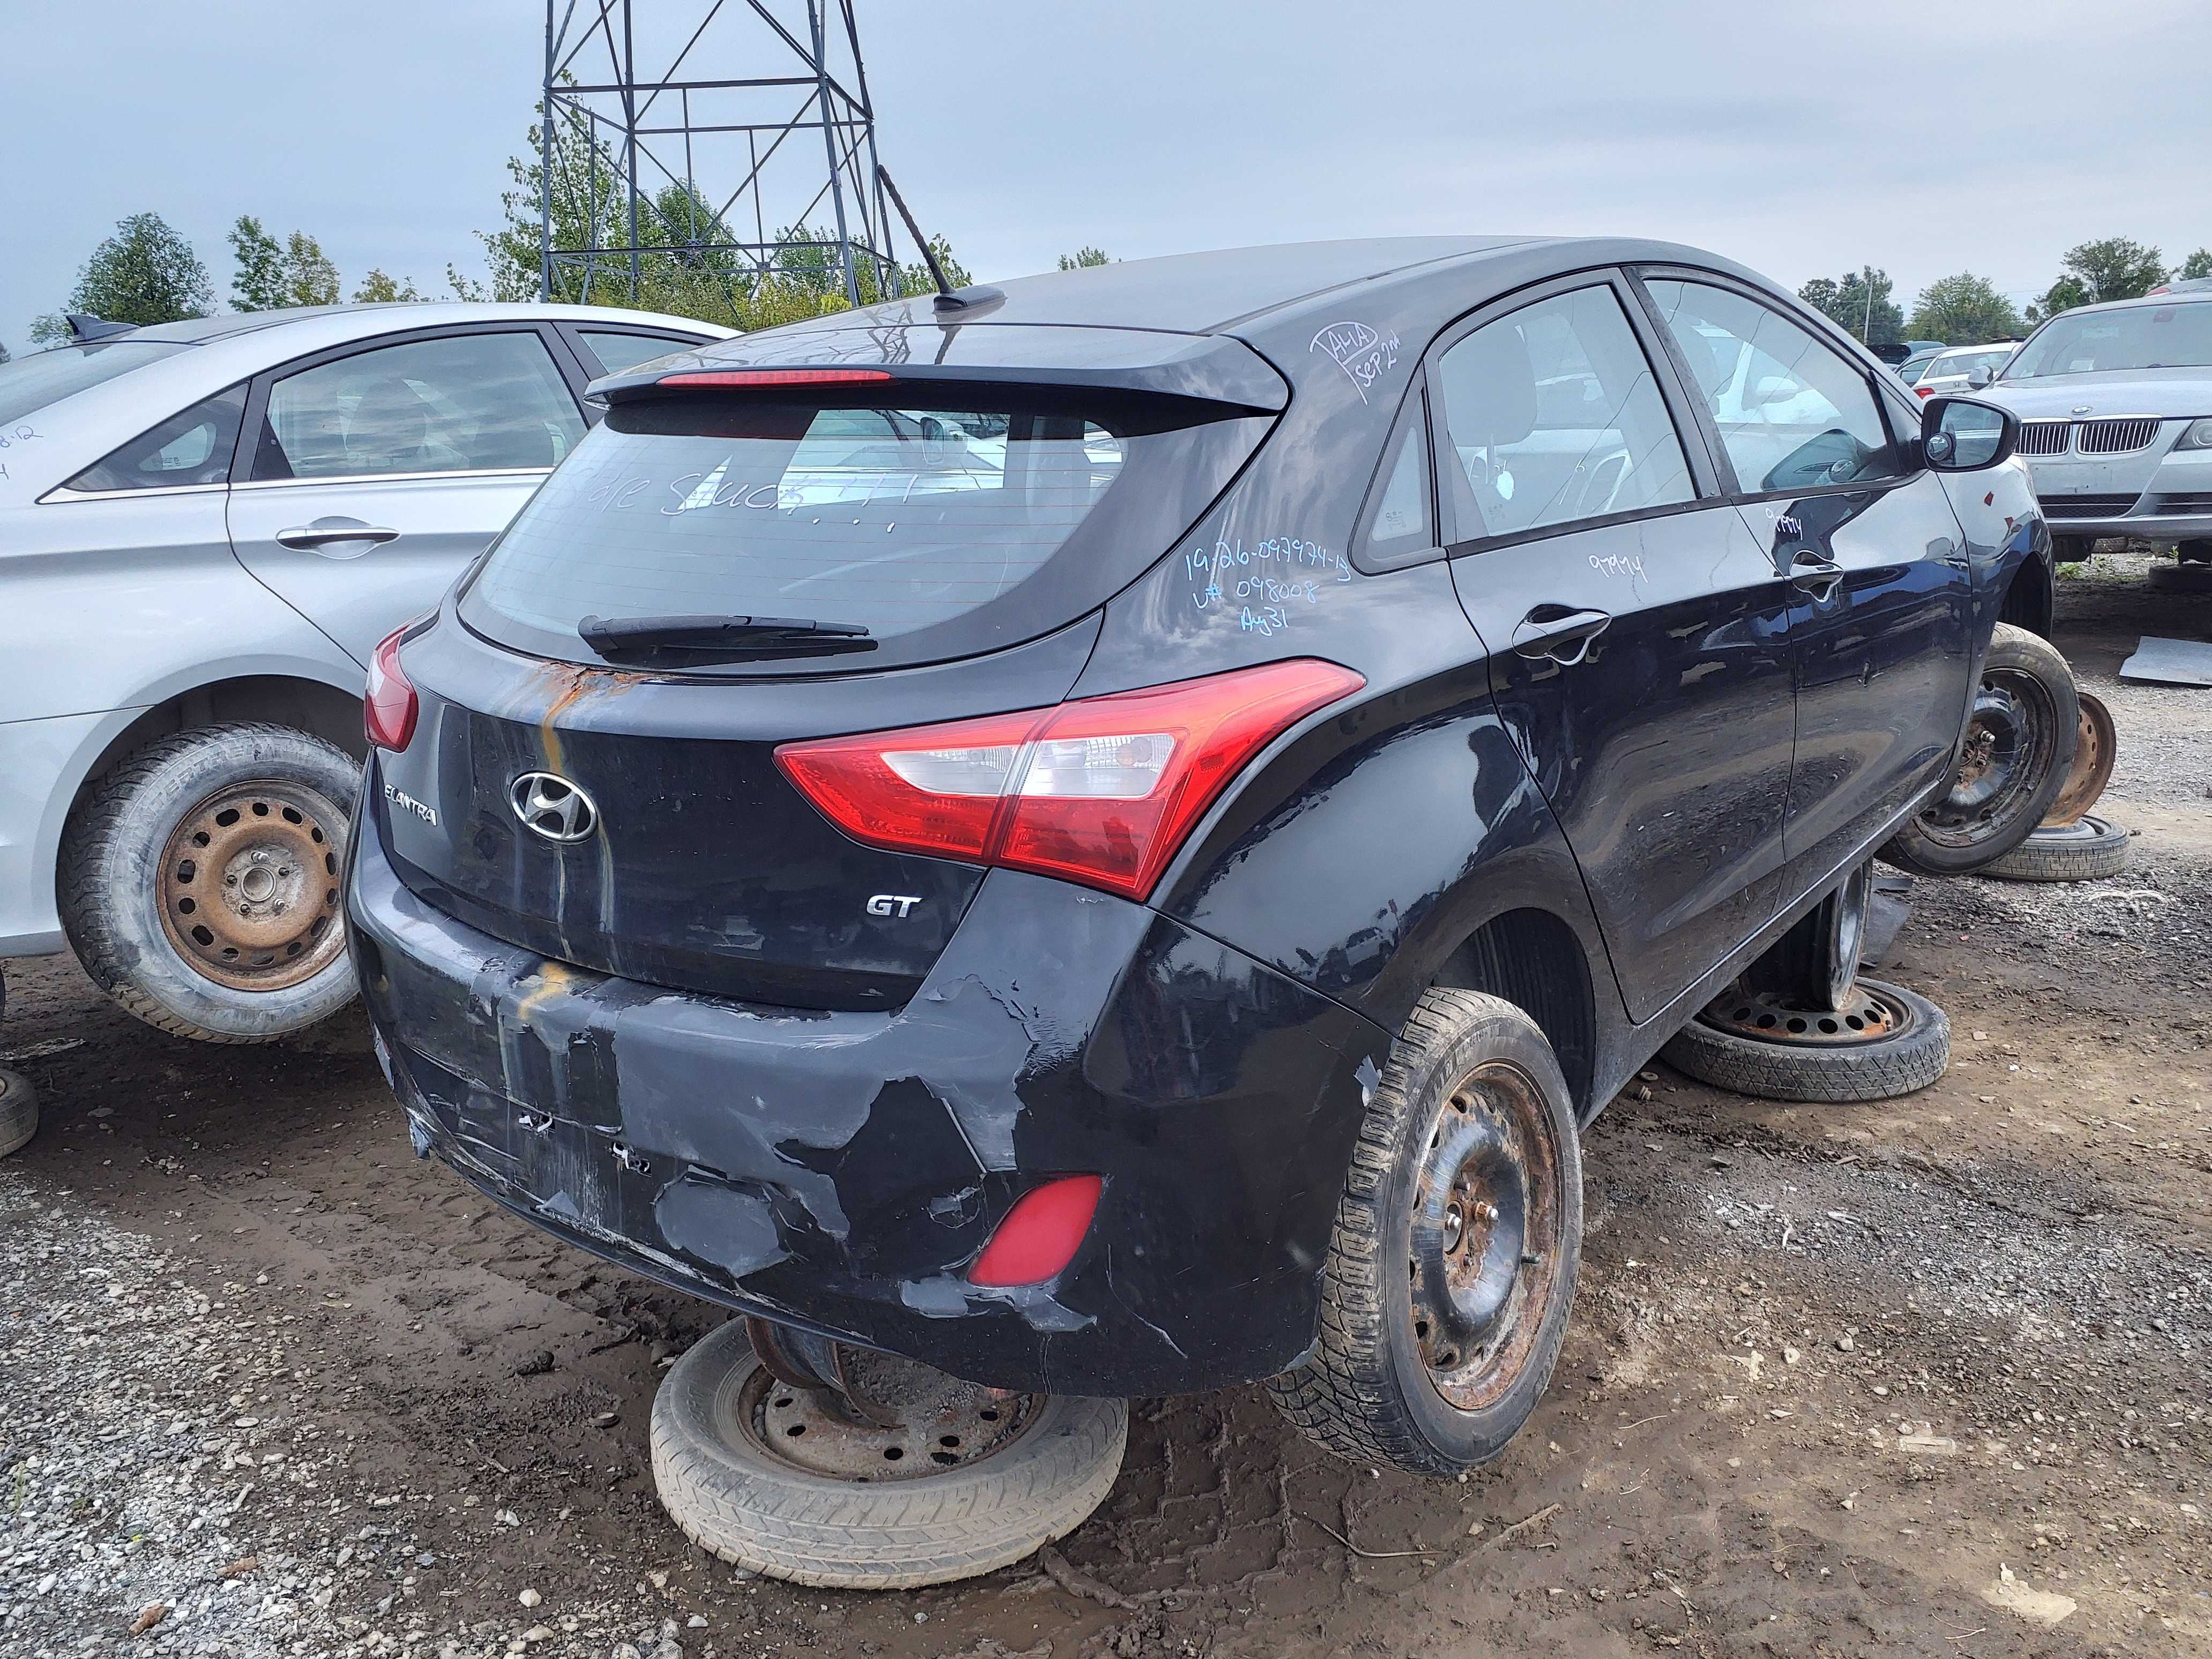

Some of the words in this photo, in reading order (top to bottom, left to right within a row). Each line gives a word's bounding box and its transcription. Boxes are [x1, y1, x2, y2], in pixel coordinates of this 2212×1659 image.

[1236, 576, 1319, 603] 098008
[385, 784, 437, 826] ELANTRA
[866, 895, 923, 918] GT
